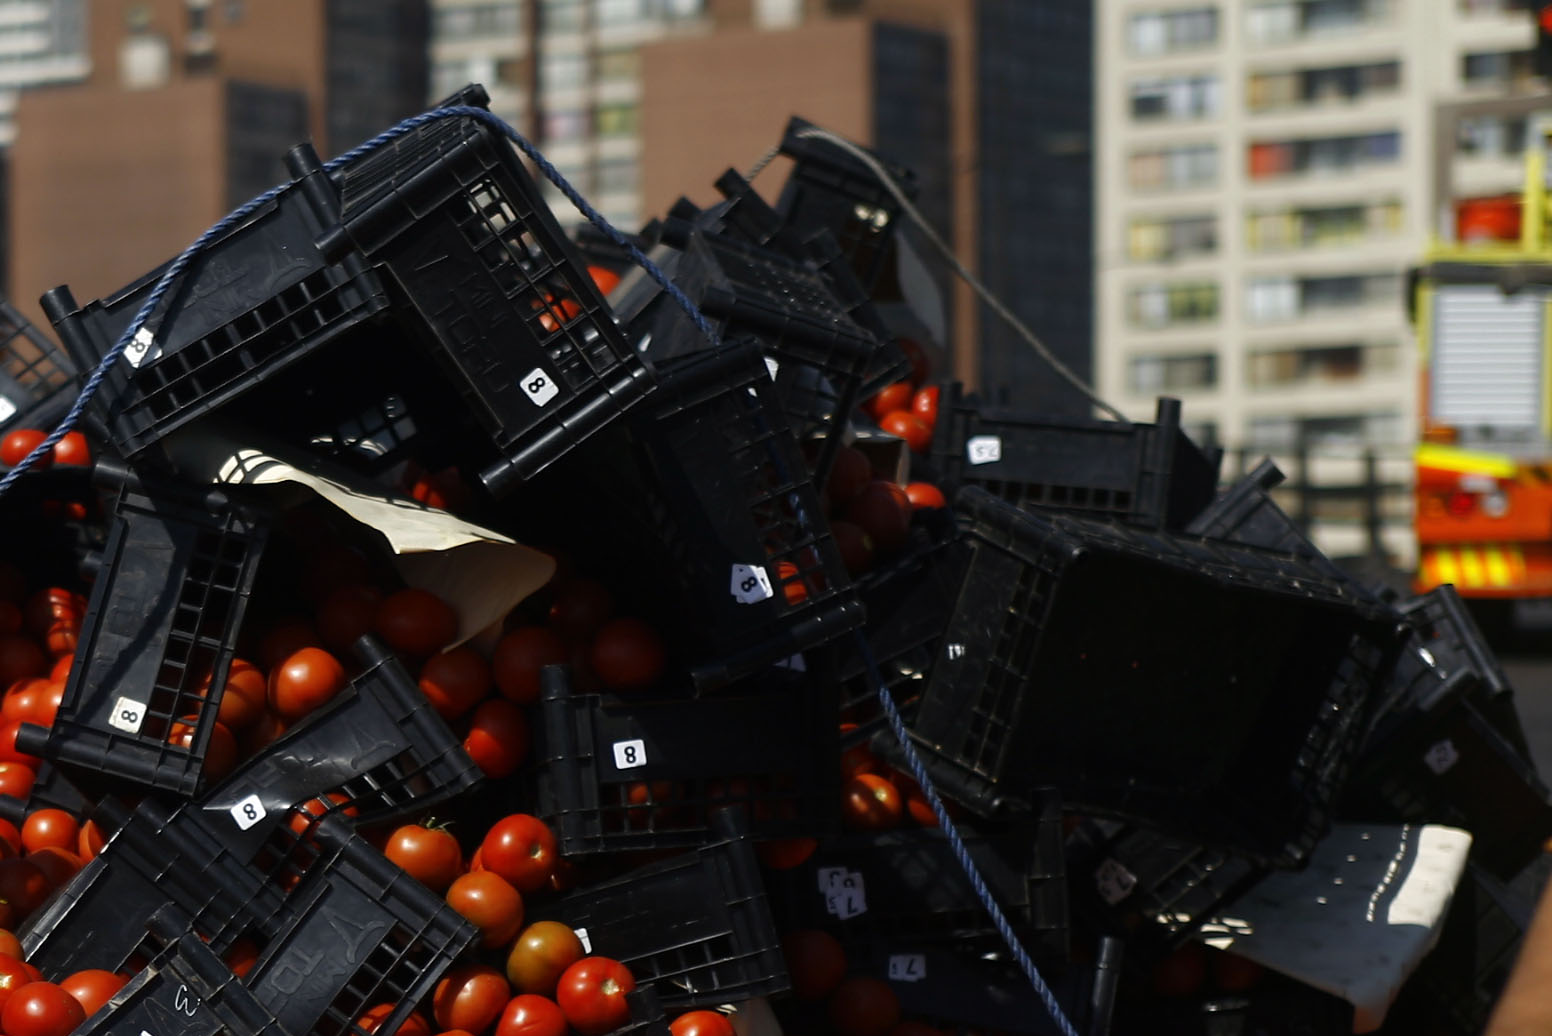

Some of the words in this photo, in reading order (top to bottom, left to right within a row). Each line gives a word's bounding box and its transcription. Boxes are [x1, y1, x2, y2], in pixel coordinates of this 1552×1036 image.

[528, 377, 545, 394] 8
[741, 576, 757, 592] 8
[121, 710, 138, 723] 8
[624, 746, 636, 764] 8
[243, 803, 257, 820] 8
